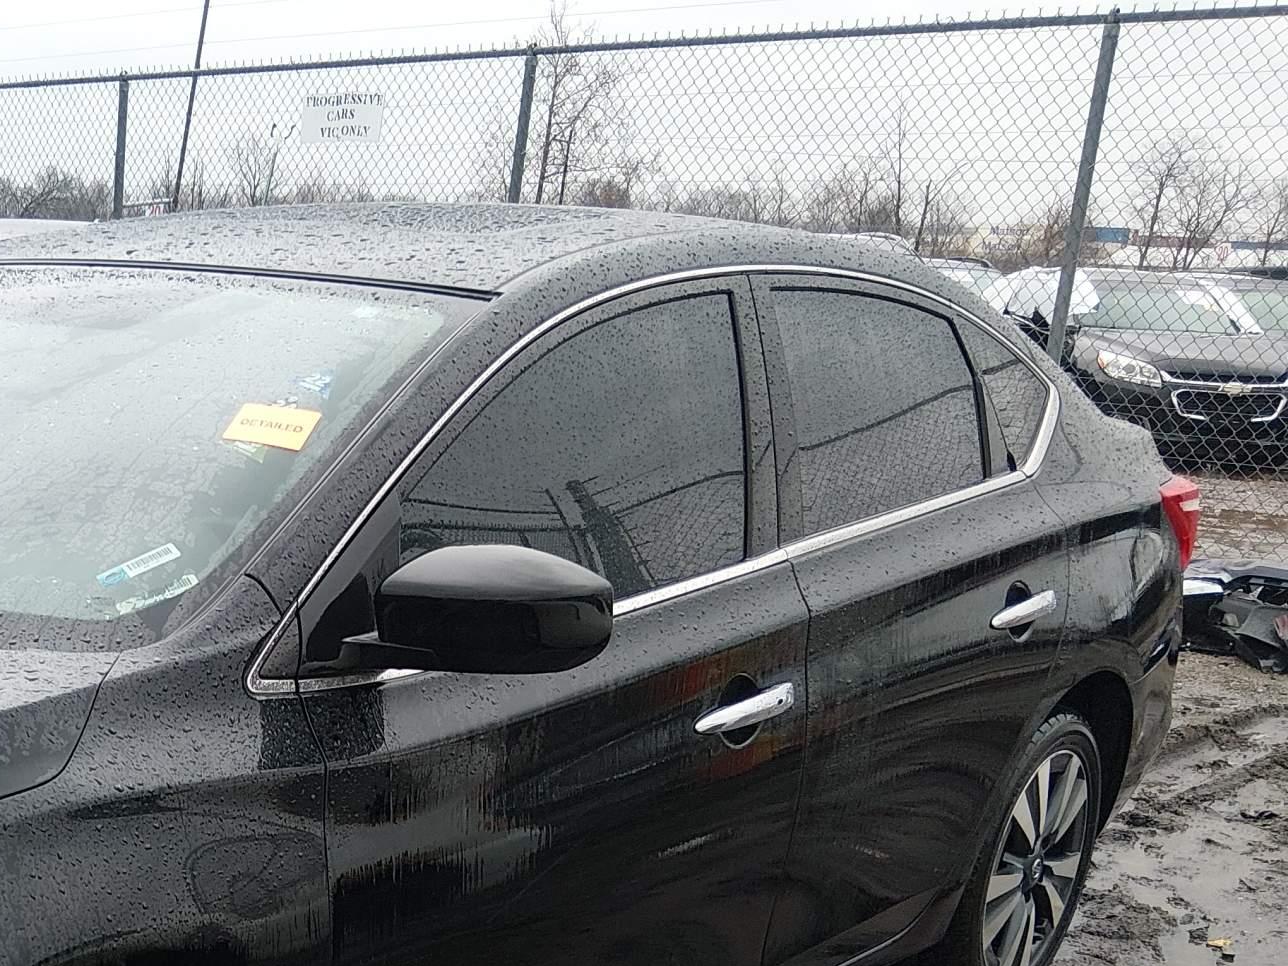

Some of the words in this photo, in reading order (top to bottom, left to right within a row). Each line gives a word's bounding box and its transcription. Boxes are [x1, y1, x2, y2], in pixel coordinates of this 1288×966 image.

[306, 92, 384, 107] PROGRESSIVE
[326, 108, 355, 122] CARS
[341, 125, 370, 137] ONLY
[239, 417, 304, 434] DETAILED
